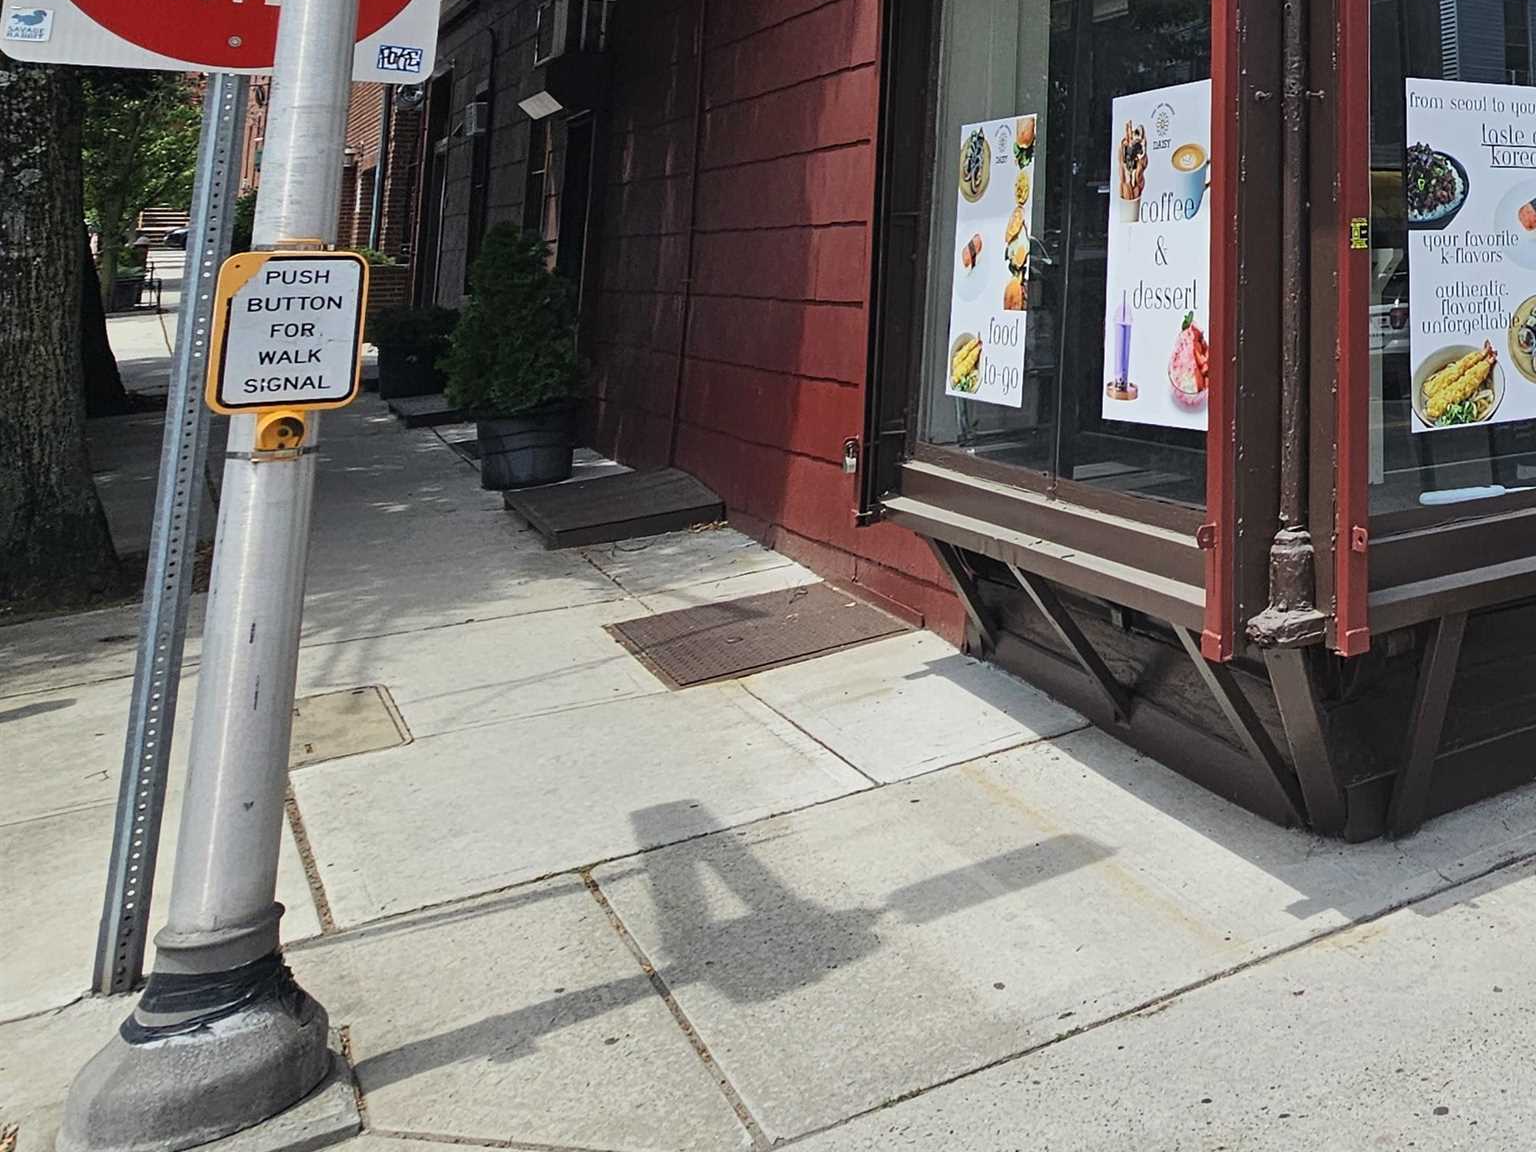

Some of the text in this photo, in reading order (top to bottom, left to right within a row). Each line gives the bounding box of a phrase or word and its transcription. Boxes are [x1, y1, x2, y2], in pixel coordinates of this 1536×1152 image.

[1409, 91, 1443, 109] from
[1450, 96, 1487, 112] seoul
[1493, 97, 1505, 113] to
[1481, 123, 1525, 145] taste
[1141, 192, 1195, 224] coffee
[1154, 234, 1169, 267] &
[1423, 230, 1519, 252] your favorite
[1441, 248, 1503, 264] k-flavors
[265, 270, 330, 285] PUSH
[1132, 279, 1199, 310] dessert
[1435, 280, 1509, 298] authentic.
[247, 296, 343, 312] BUTTON
[270, 322, 316, 338] FOR
[988, 316, 1019, 347] food
[258, 348, 322, 365] WALK
[243, 375, 331, 393] SIGNAL
[984, 357, 1019, 394] to-go
